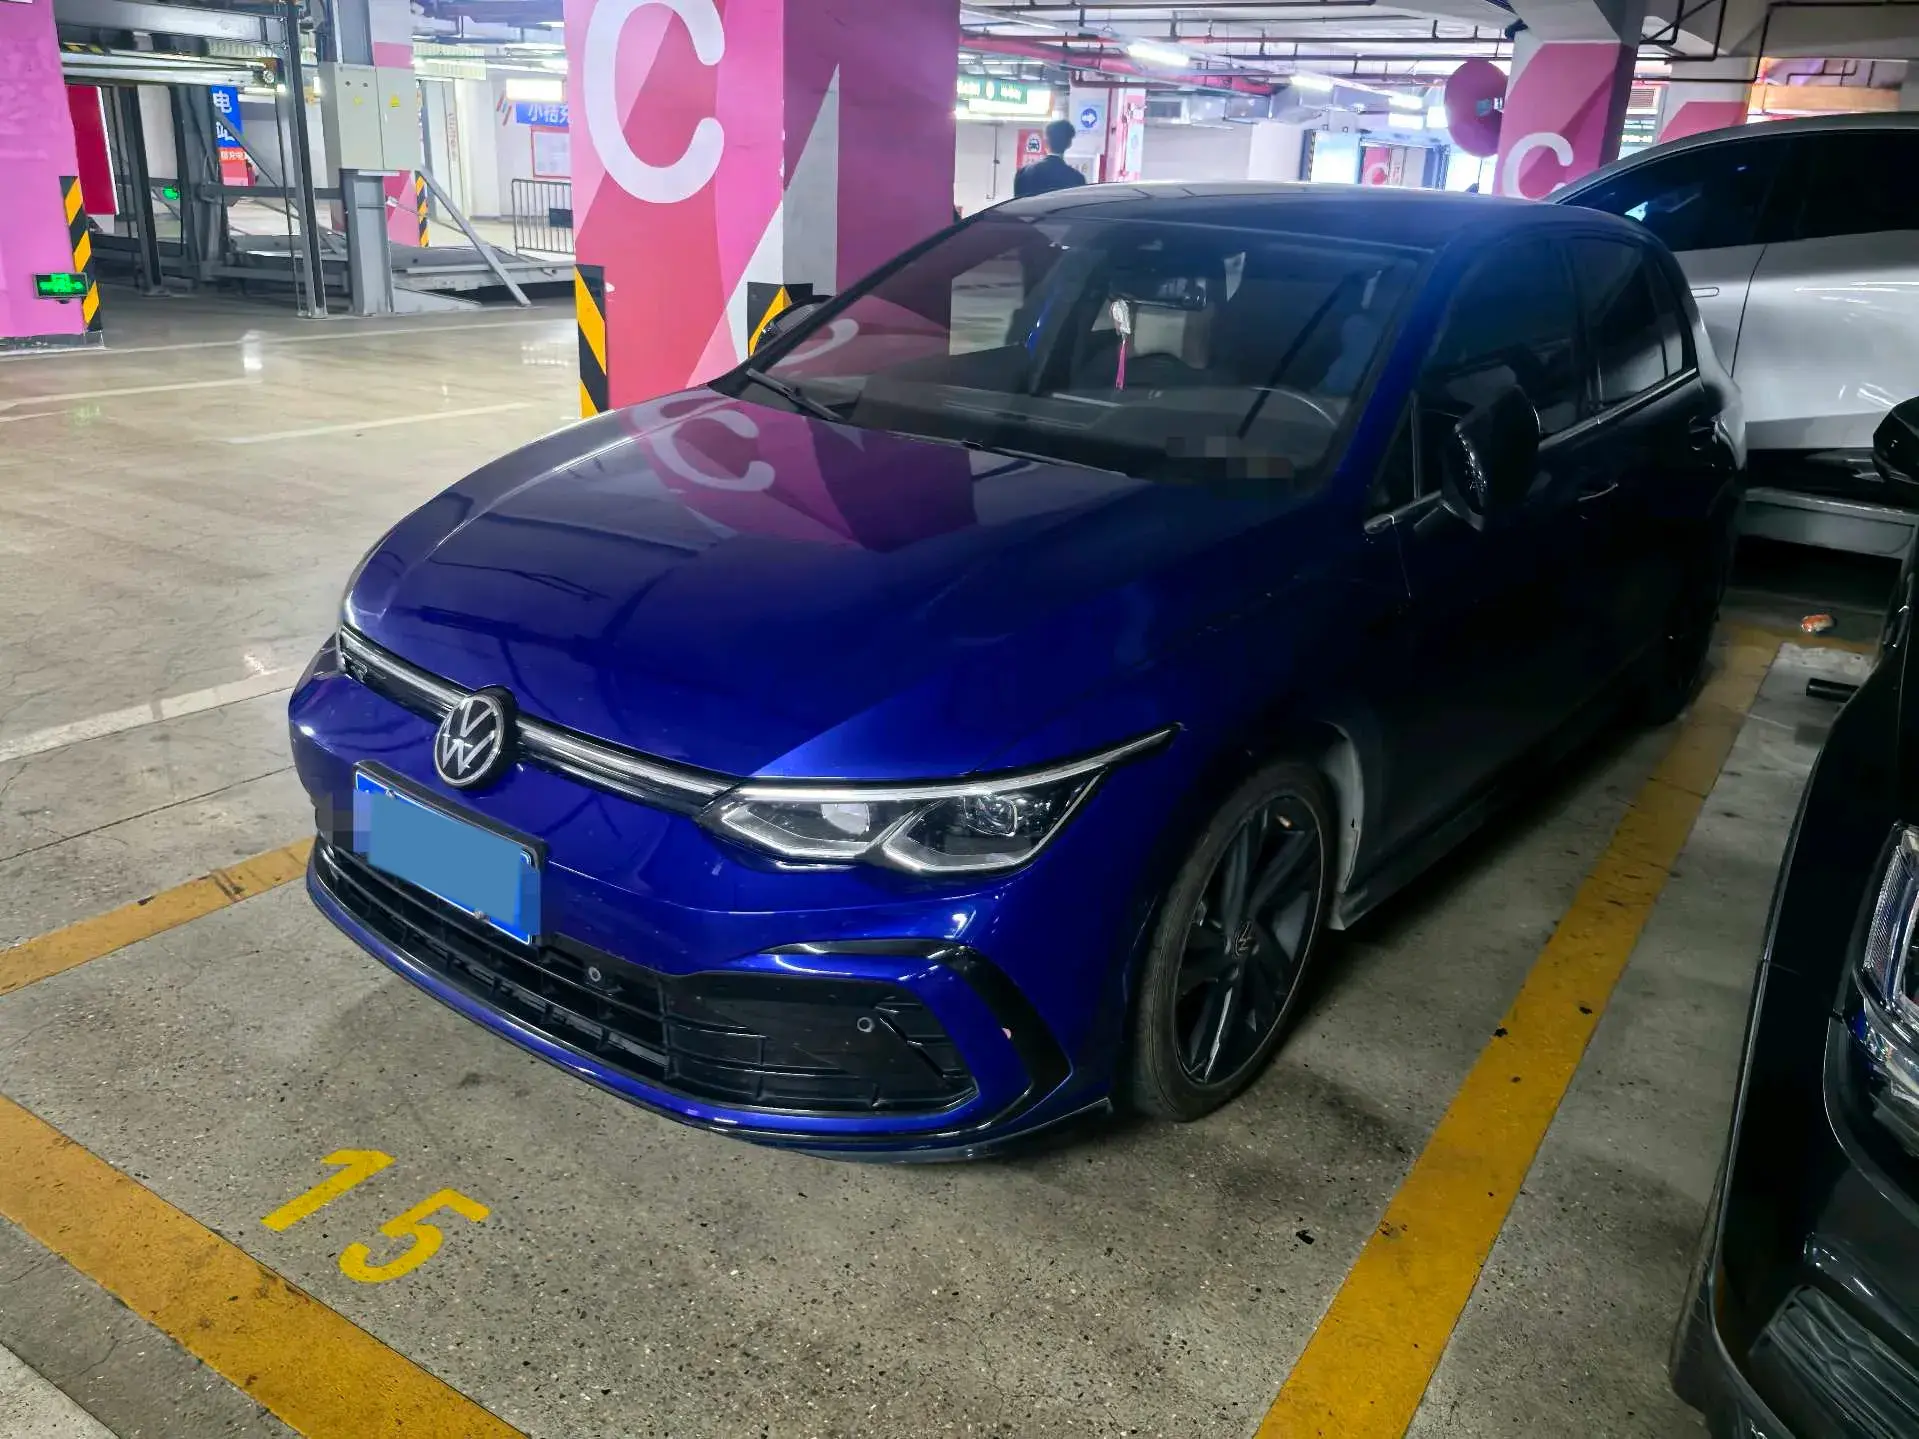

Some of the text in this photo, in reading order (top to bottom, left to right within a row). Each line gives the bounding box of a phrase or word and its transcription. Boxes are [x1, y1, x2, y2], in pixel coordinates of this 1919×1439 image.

[583, 0, 725, 204] C
[1502, 132, 1574, 201] C
[259, 1147, 492, 1284] 15
